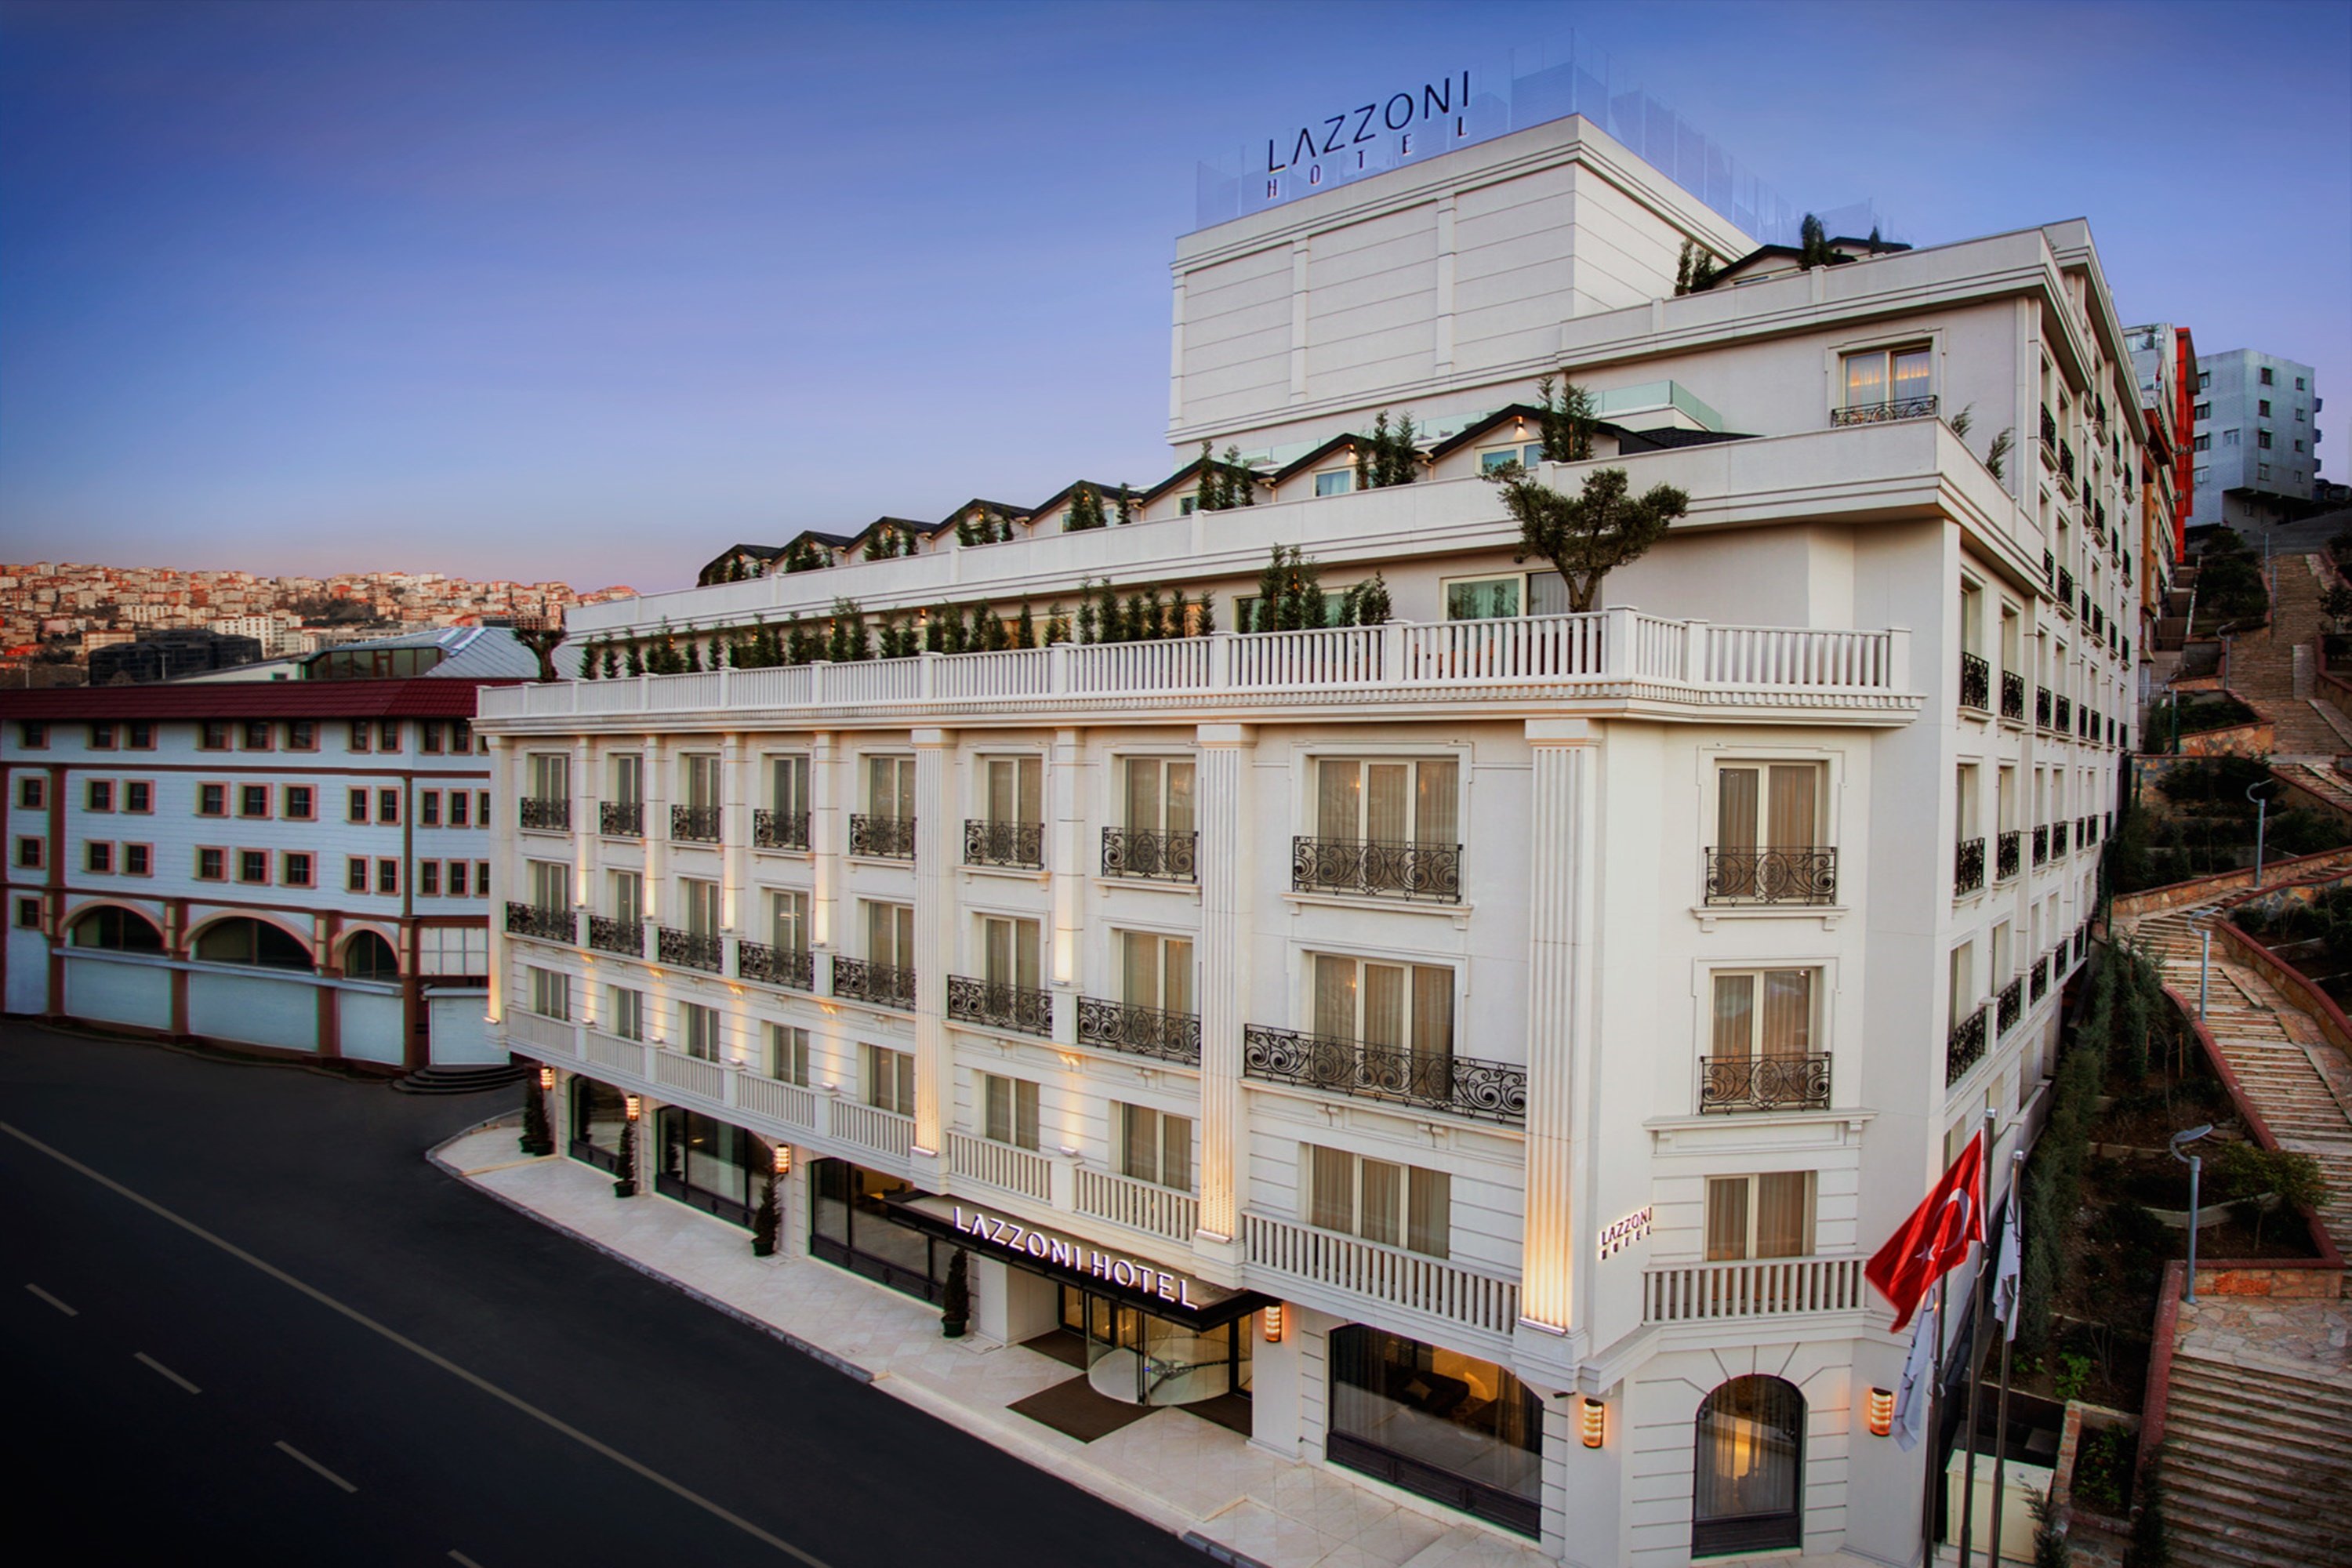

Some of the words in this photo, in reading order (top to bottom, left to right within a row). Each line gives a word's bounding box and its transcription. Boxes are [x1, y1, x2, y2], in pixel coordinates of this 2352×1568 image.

[1268, 117, 1468, 198] HOTEL
[1269, 71, 1468, 172] LAZZONI
[954, 1206, 1082, 1271] LAZZONI
[1091, 1250, 1198, 1310] HOTEL
[1602, 1207, 1651, 1246] LAZZONI
